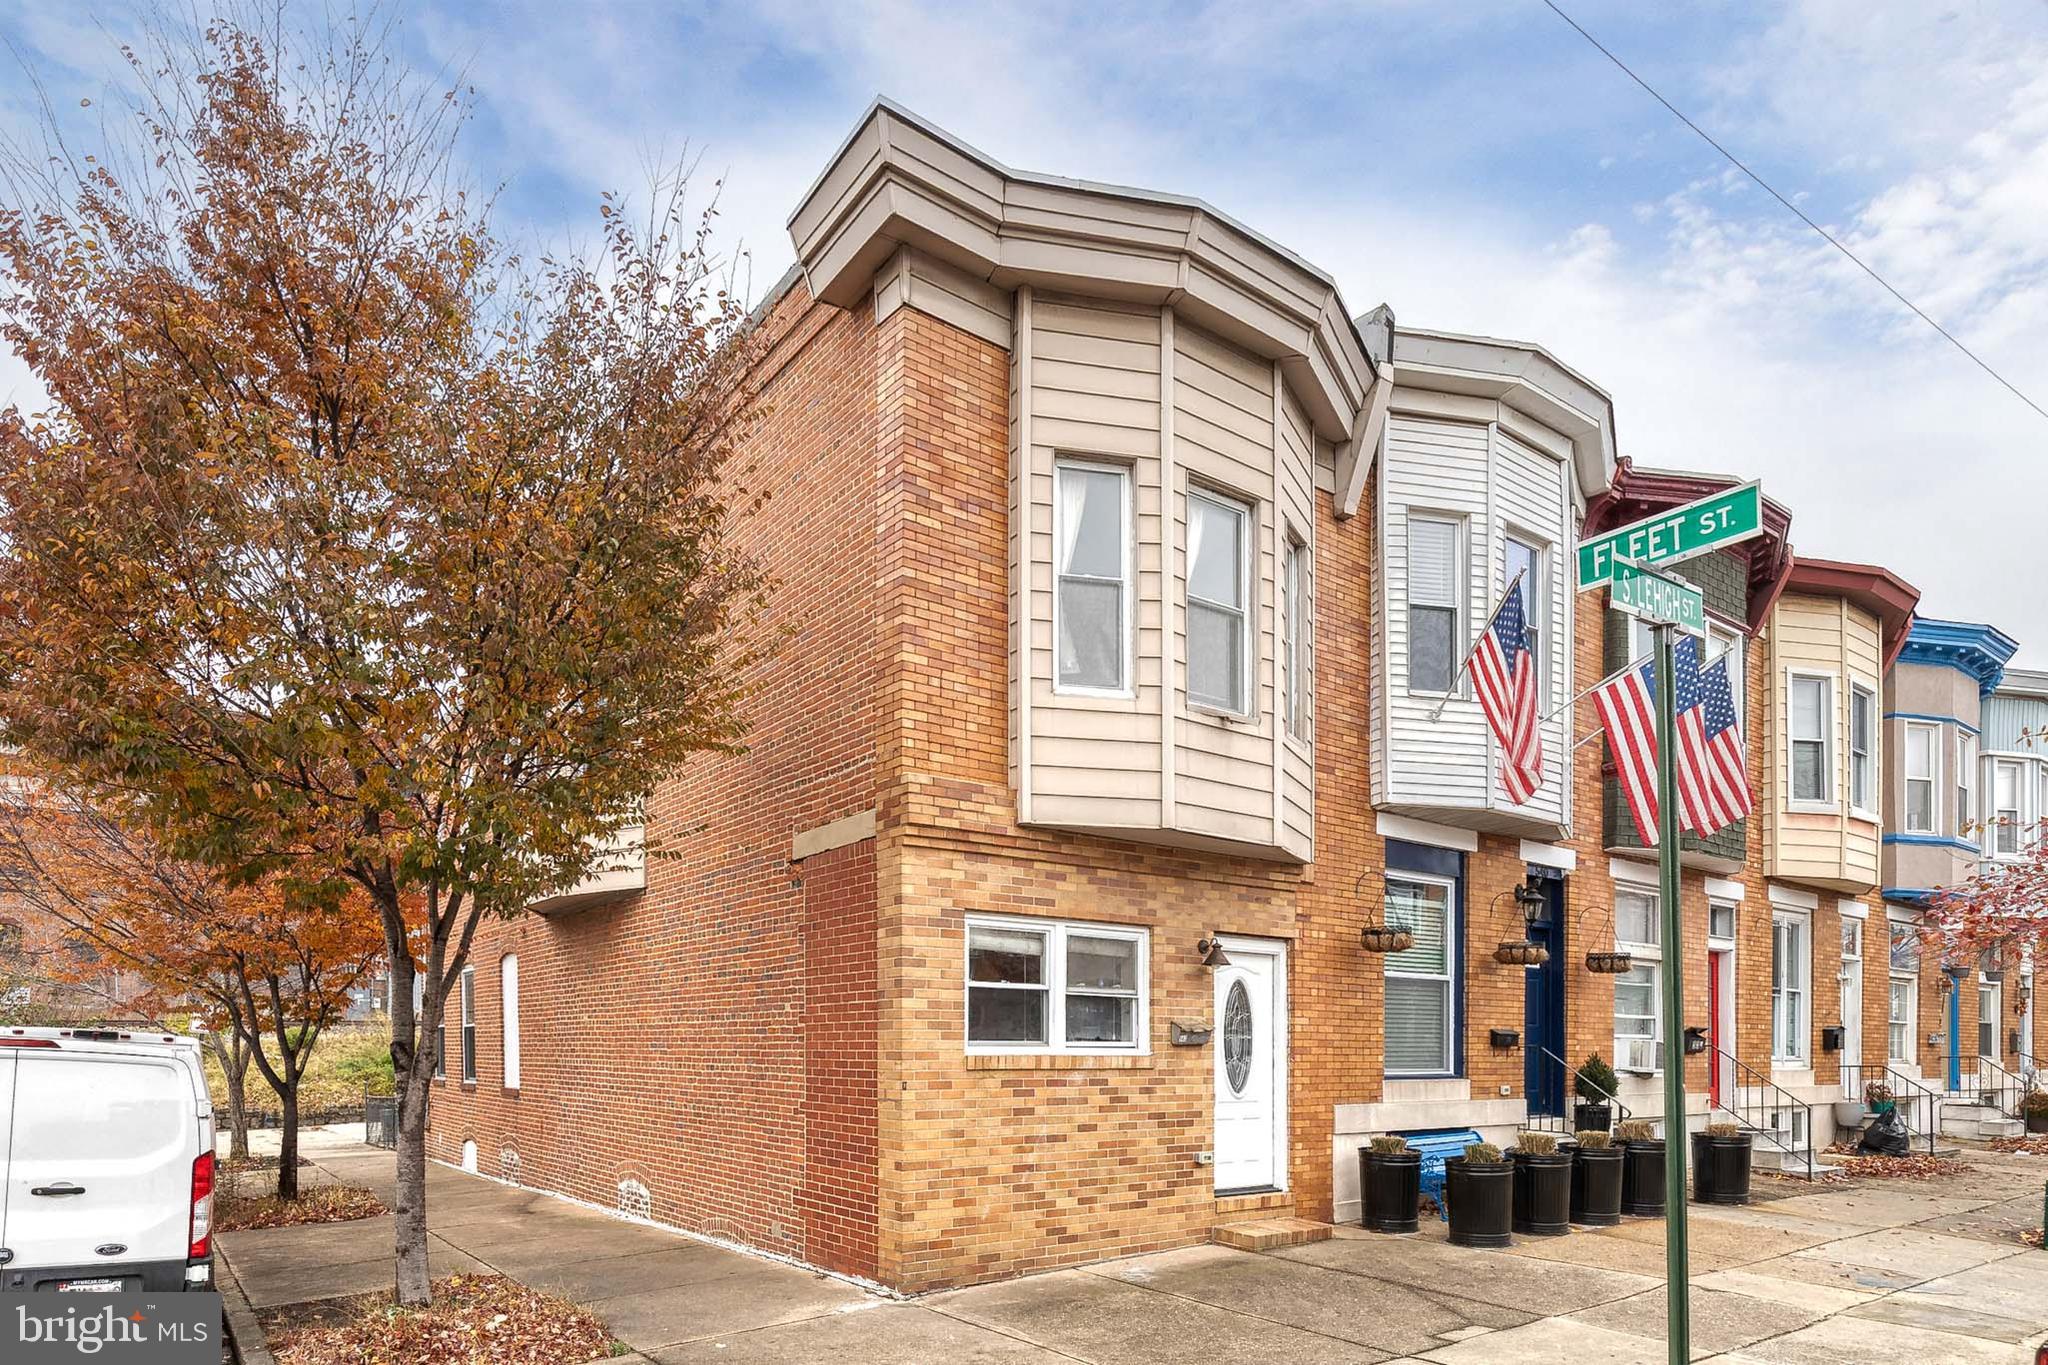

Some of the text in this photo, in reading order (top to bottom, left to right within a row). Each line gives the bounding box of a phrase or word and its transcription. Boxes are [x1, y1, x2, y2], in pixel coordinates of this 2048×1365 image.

[1700, 505, 1736, 535] ST.
[1622, 569, 1697, 623] S. LEHIGH ST.
